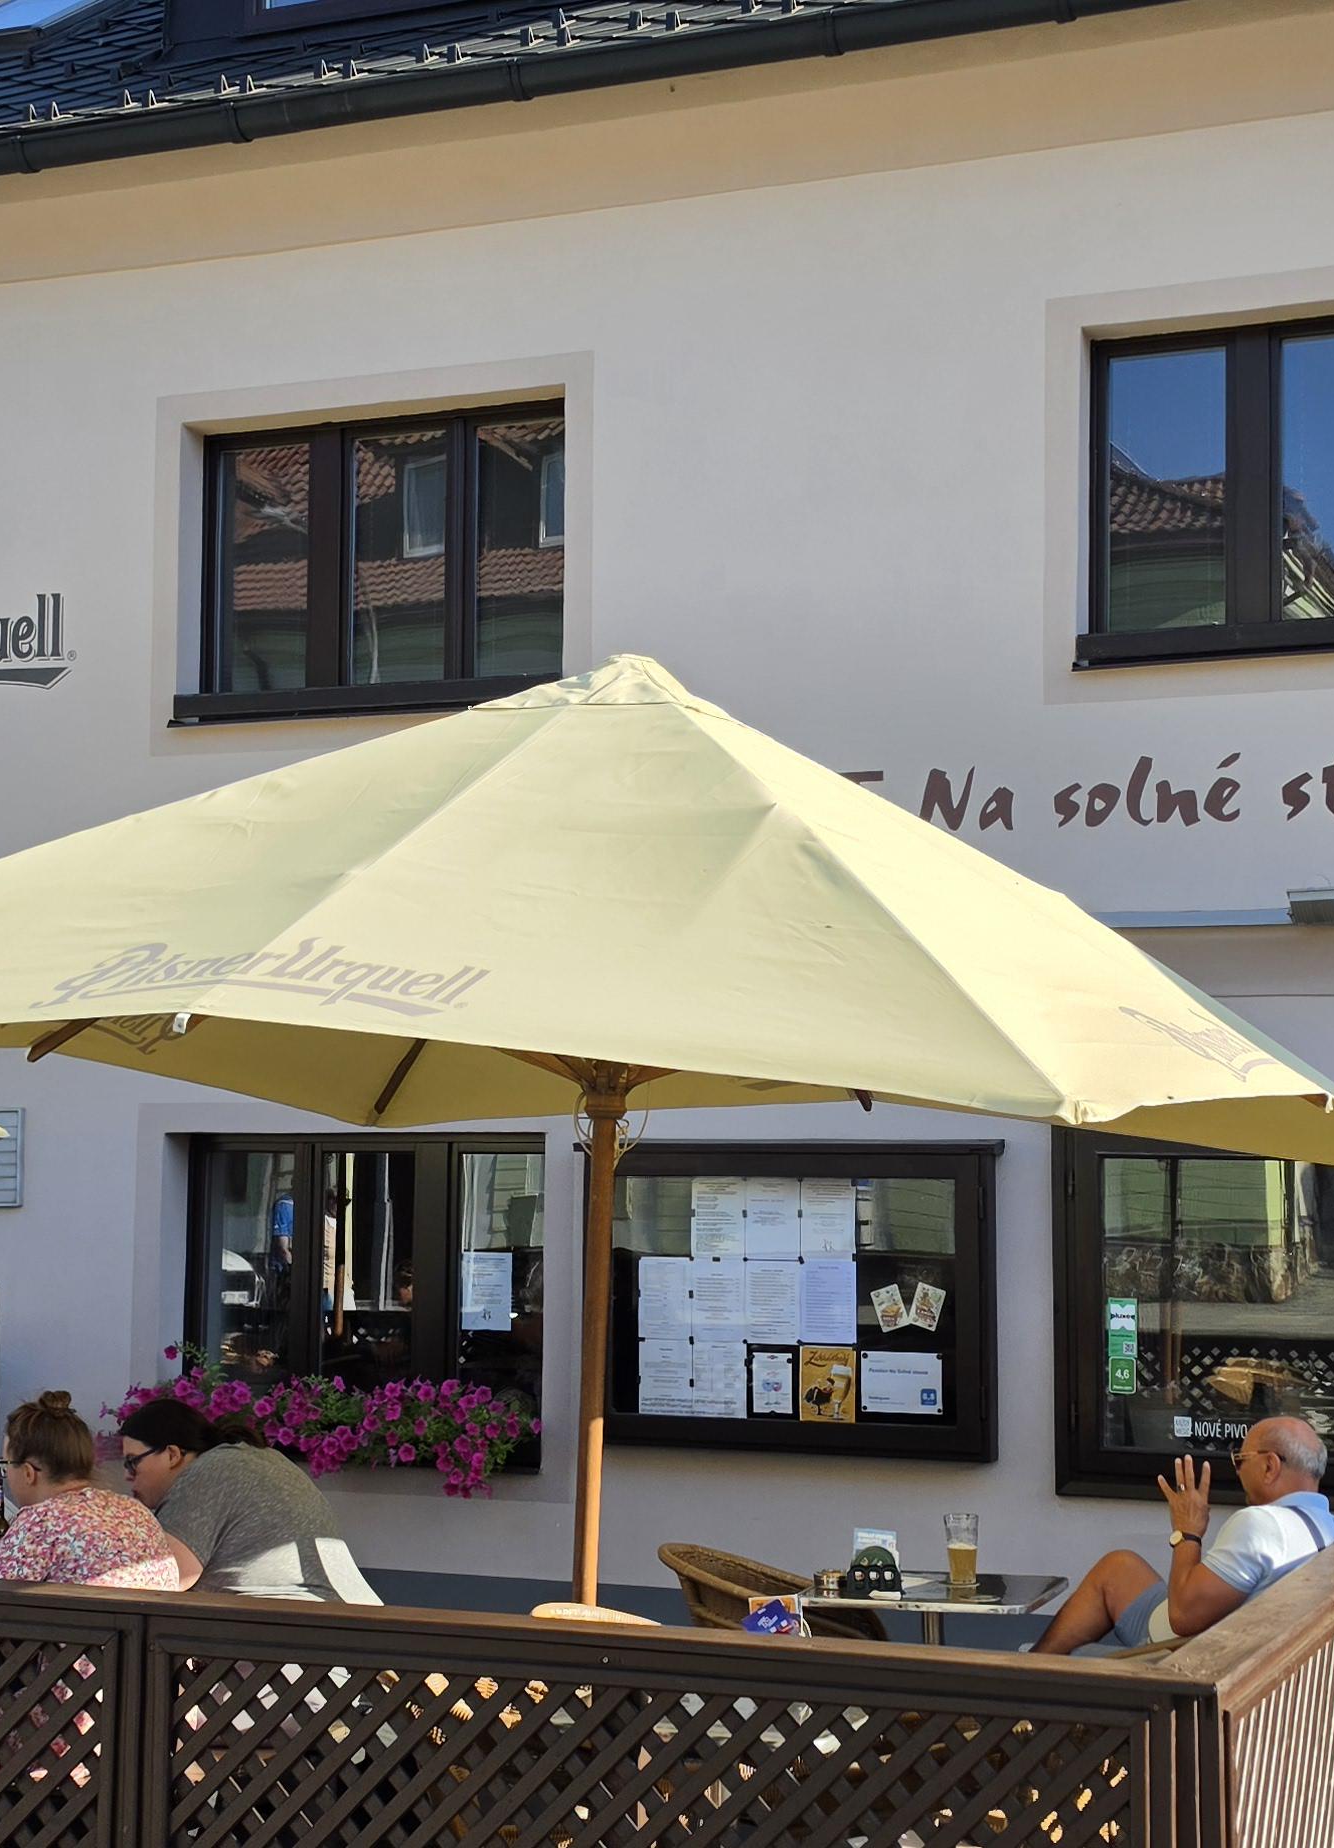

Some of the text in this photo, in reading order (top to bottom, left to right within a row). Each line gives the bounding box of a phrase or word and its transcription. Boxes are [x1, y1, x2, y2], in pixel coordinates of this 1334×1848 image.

[919, 766, 1014, 831] Na
[1054, 752, 1241, 827] solné
[33, 936, 491, 1008] Pilsner Urquell
[1194, 1418, 1222, 1438] NOVÉ
[1224, 1423, 1248, 1439] PIVO
